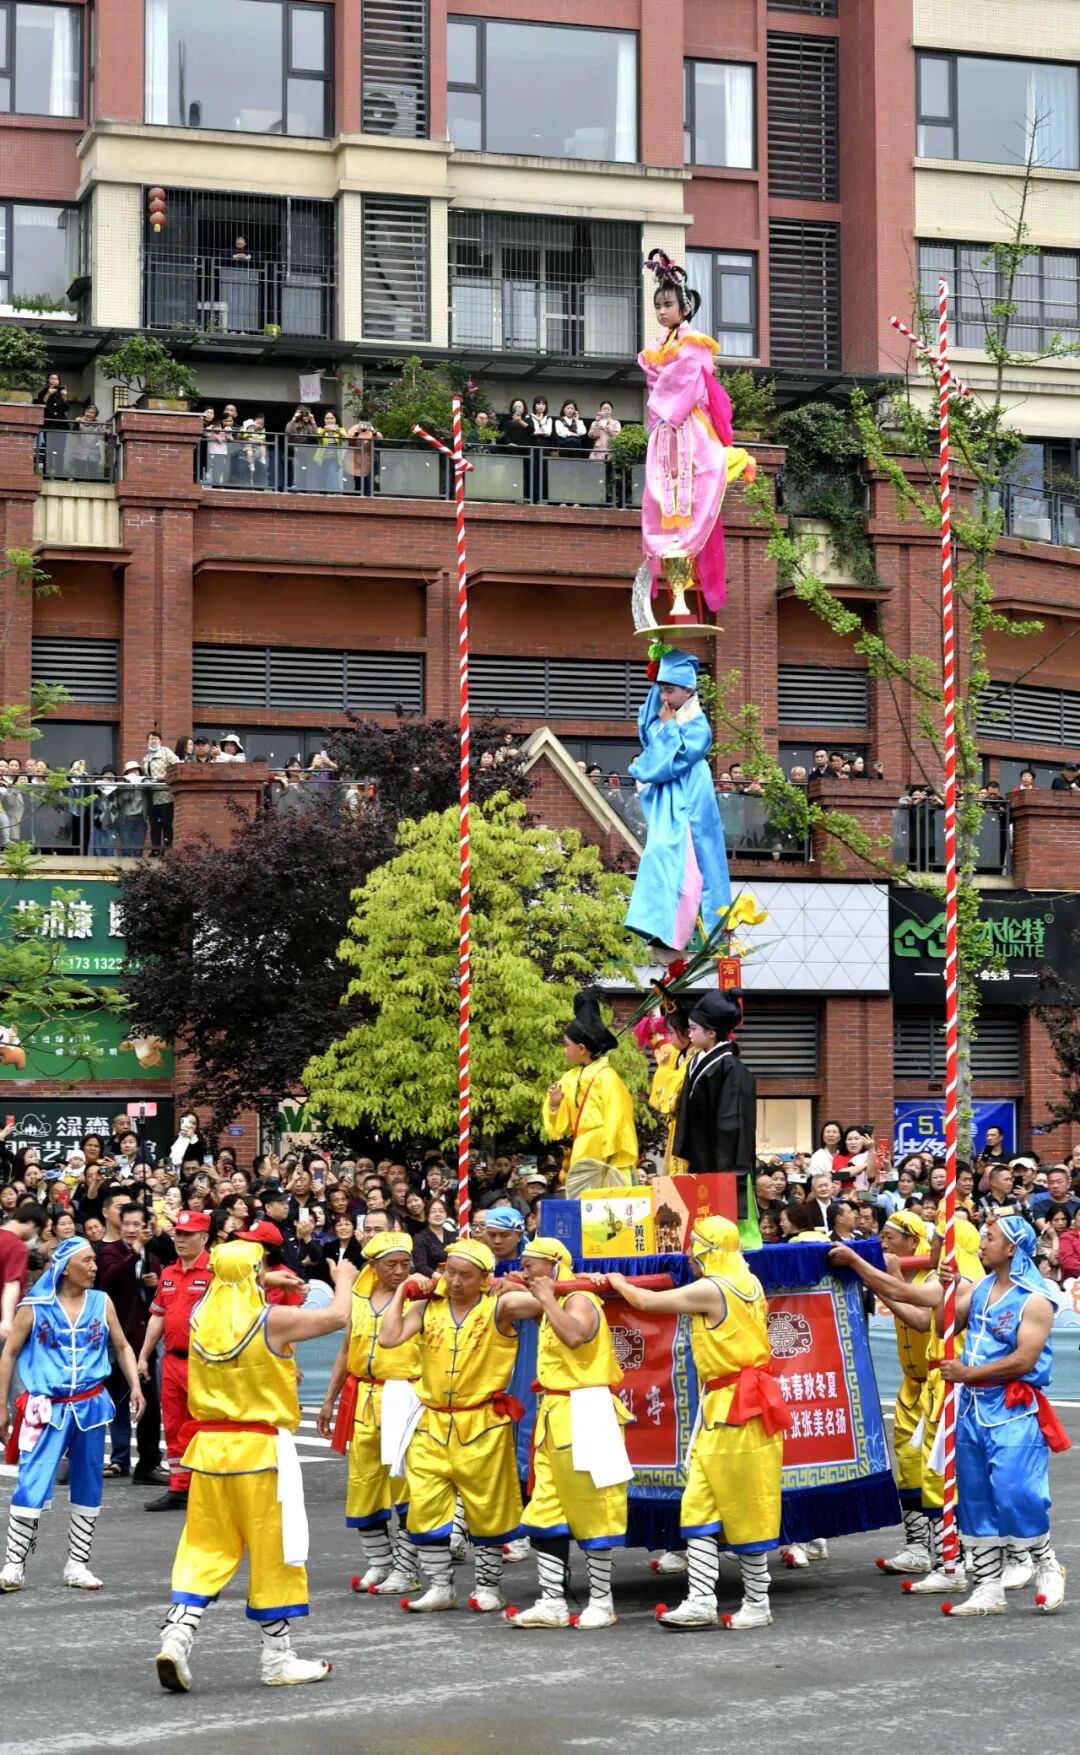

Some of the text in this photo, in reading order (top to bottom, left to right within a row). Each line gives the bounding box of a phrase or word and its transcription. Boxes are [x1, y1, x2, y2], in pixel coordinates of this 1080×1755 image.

[634, 1224, 645, 1252] 黄花
[774, 1371, 838, 1402] 东春秋冬夏
[784, 1407, 847, 1441] 张张美名扬
